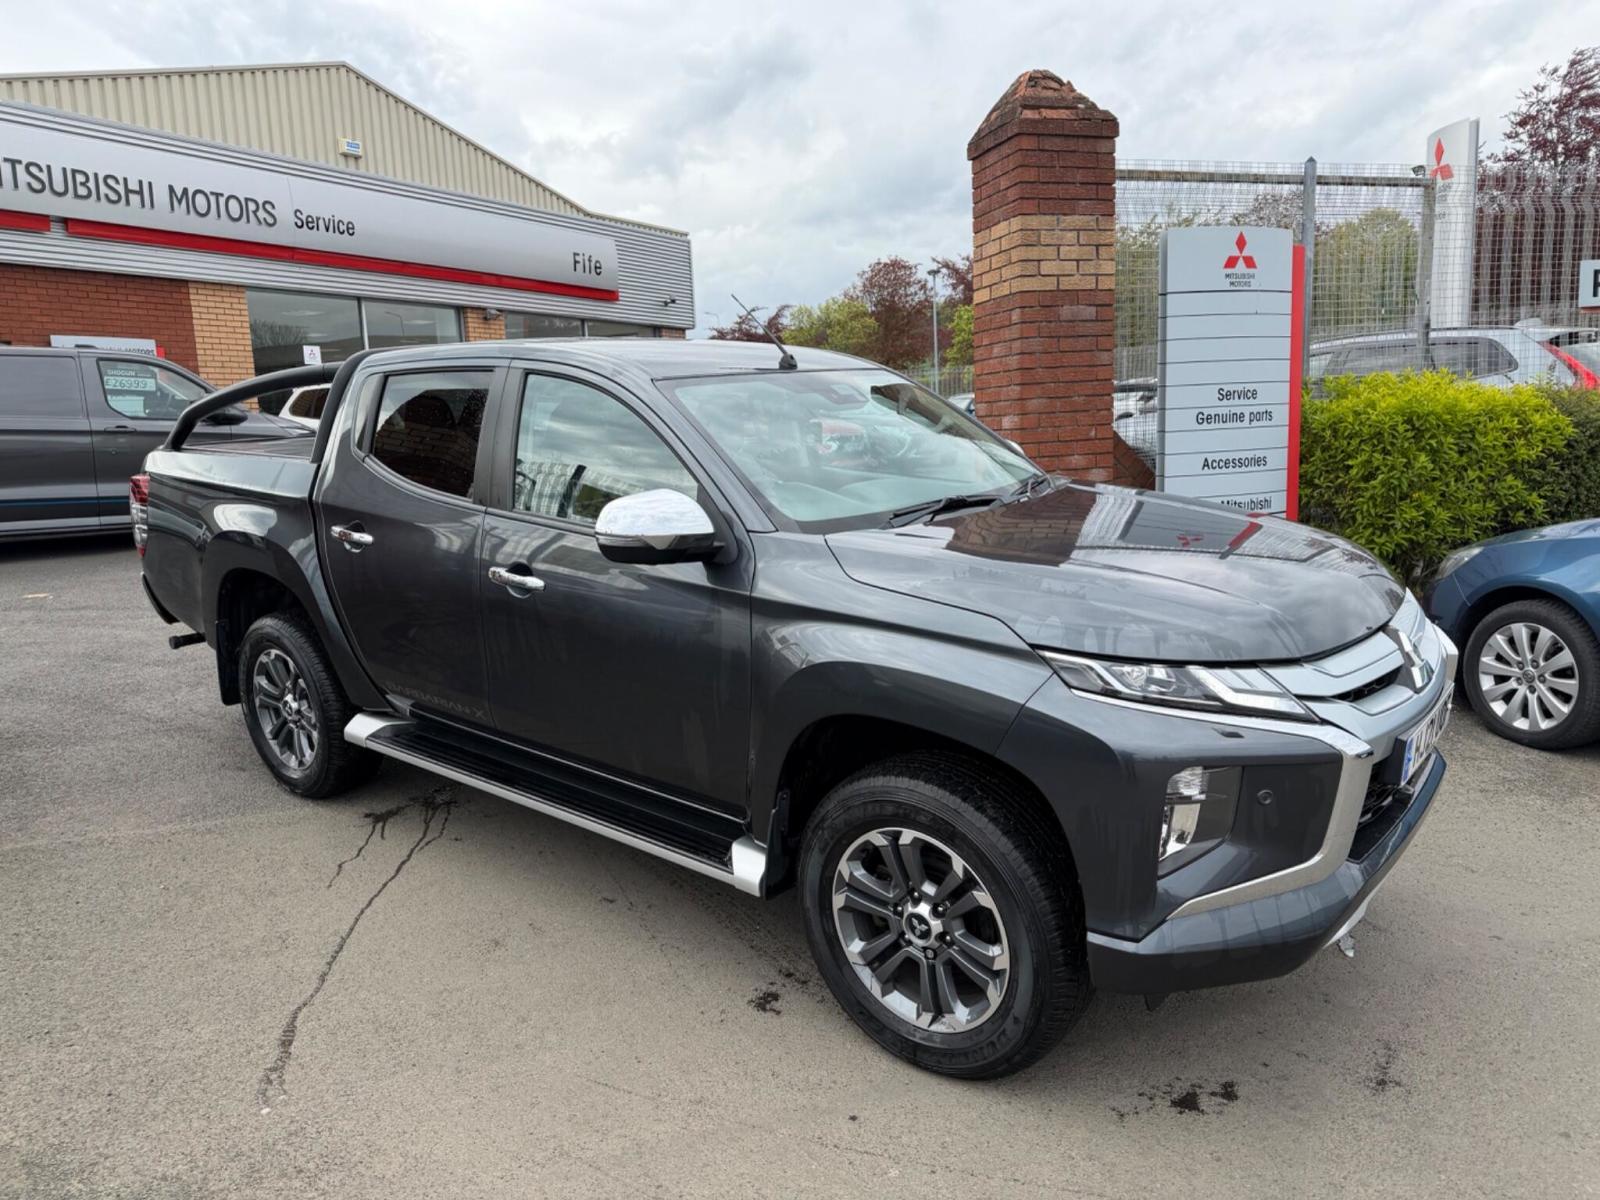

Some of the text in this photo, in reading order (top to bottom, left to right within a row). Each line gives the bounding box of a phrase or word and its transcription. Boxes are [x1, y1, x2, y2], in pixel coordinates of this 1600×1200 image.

[168, 184, 278, 228] MOTORS
[294, 208, 356, 237] Service
[572, 251, 603, 276] Fife
[1224, 272, 1256, 280] MITSUBISHI
[1229, 280, 1252, 288] MOTORS
[1217, 387, 1258, 401] Service
[1195, 408, 1273, 425] Genuine parts
[1201, 454, 1268, 471] Accessories
